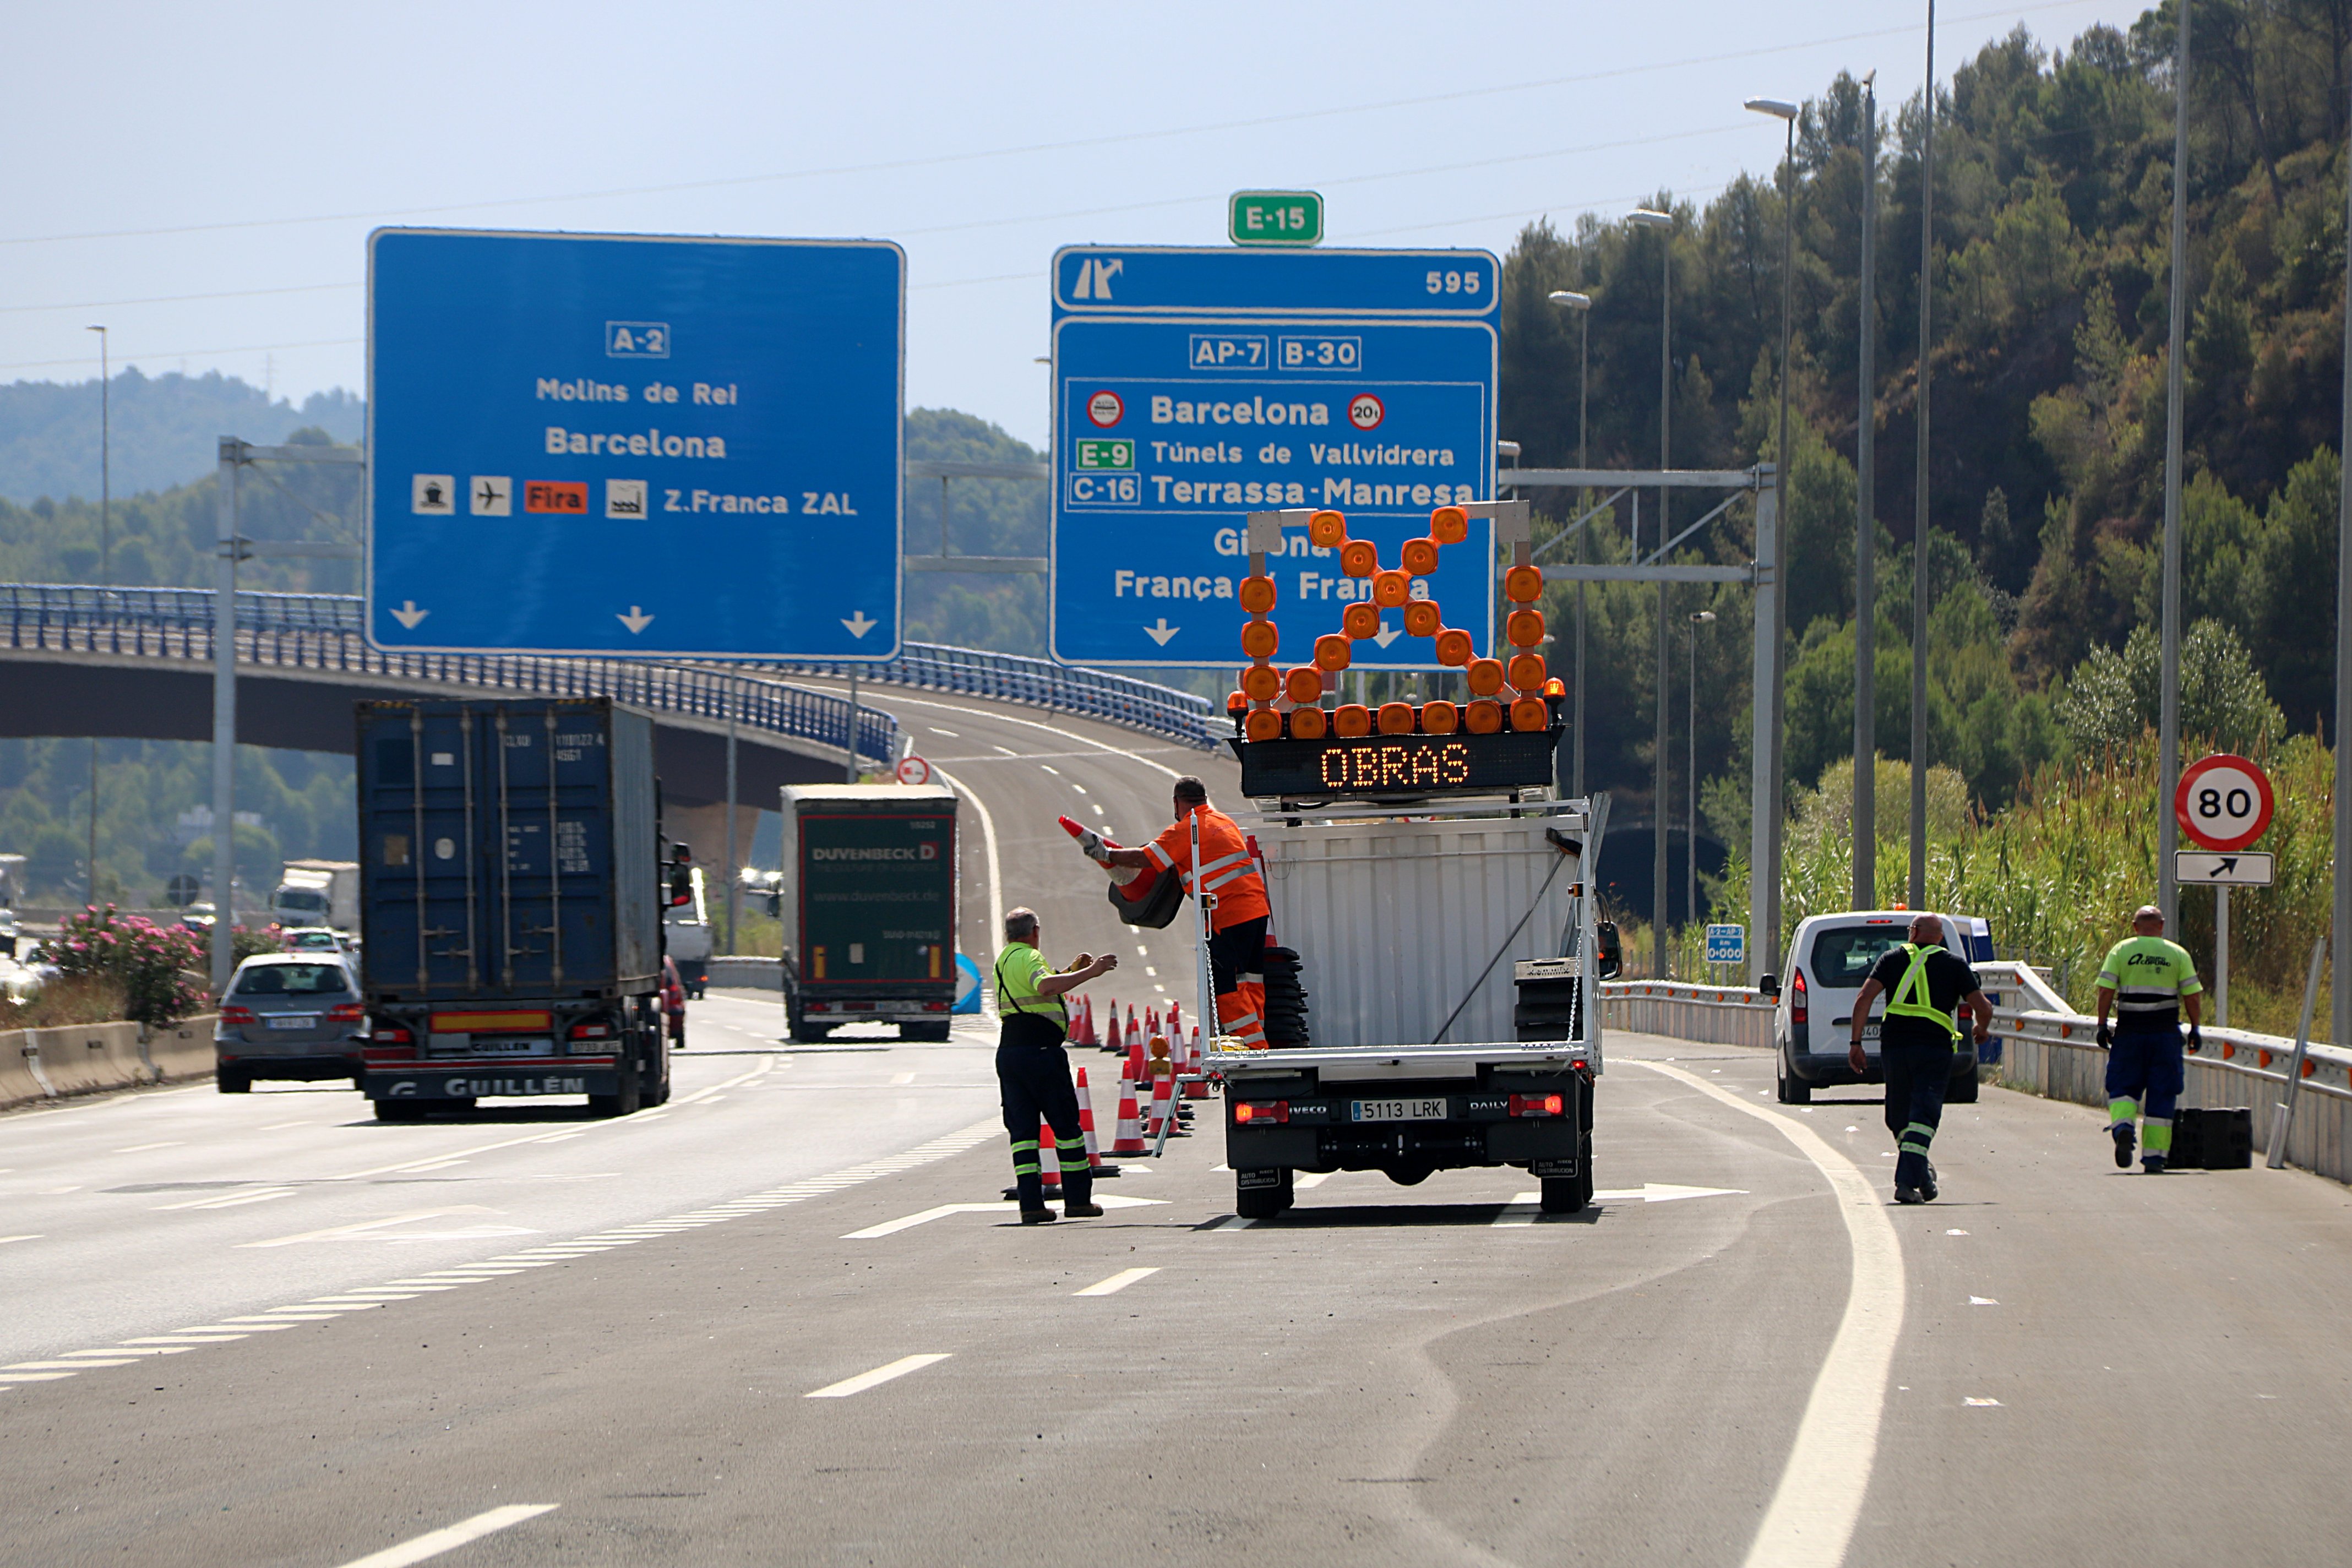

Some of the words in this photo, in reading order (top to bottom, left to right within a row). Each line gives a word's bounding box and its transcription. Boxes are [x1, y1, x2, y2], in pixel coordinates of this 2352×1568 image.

[1247, 207, 1305, 230] E-15
[1427, 271, 1480, 294] 595
[613, 328, 665, 352] A-2
[1195, 342, 1262, 364] AP-7
[1286, 342, 1356, 365] B-30
[536, 378, 629, 402] Molins
[645, 382, 679, 404] de
[693, 382, 737, 406] Rei
[1151, 396, 1329, 426] Barcelona
[545, 427, 726, 459] Barcelona
[1081, 443, 1129, 466] E-9
[1151, 440, 1243, 464] Túnels
[1259, 442, 1291, 464] de
[1310, 443, 1455, 466] Vallvidrera
[529, 486, 582, 509] Fira
[1074, 478, 1136, 500] C-16
[664, 489, 788, 515] Z.Franca
[802, 492, 857, 516] ZAL
[1115, 569, 1233, 602] França
[1300, 571, 1430, 600] Frana
[1321, 744, 1469, 787] OBRAS
[2199, 789, 2252, 818] 80
[812, 848, 916, 861] DUVENBECK
[444, 1076, 585, 1096] GUILLÉN
[1288, 1106, 1327, 1114] IVECO
[1364, 1102, 1403, 1118] 5113
[1413, 1101, 1441, 1117] LRK
[1470, 1101, 1509, 1110] DAILY
